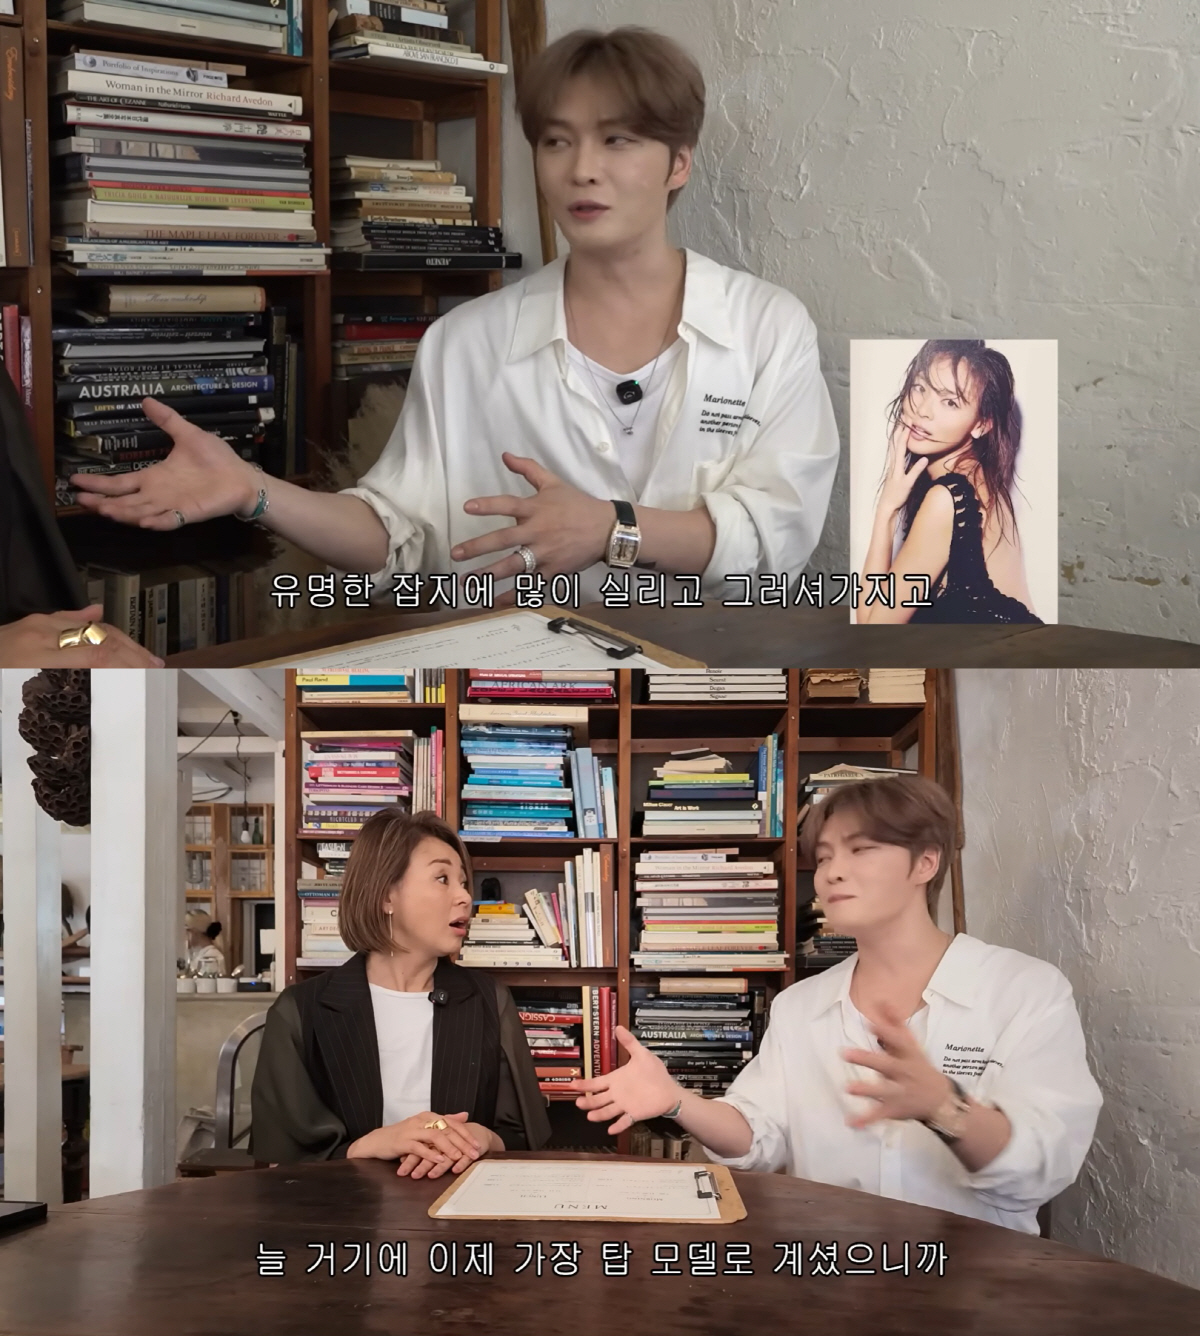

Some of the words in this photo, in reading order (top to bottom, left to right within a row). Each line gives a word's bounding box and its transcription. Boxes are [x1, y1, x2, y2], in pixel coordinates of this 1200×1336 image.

[102, 60, 132, 72] Portfolio
[132, 62, 142, 72] of
[141, 64, 179, 78] Inspirations
[105, 79, 144, 92] Woman
[144, 83, 154, 94] in
[156, 84, 172, 96] the
[172, 86, 204, 99] Mirror
[206, 91, 241, 104] Richard
[242, 96, 274, 107] Avedon
[144, 229, 168, 240] THE
[170, 230, 202, 241] MAPLE
[204, 230, 233, 242] LEAF
[234, 232, 280, 242] FOREVER
[79, 382, 166, 399] AUSTRALIA
[170, 382, 222, 391] ARCHITECTURE
[232, 381, 258, 389] DESIGN
[94, 404, 115, 412] LOFTS
[703, 393, 746, 407] Marionette
[592, 989, 600, 1010] BERT
[592, 1012, 600, 1036] STERN
[640, 1030, 687, 1039] AUSTRALIA
[944, 1043, 985, 1053] Marionette
